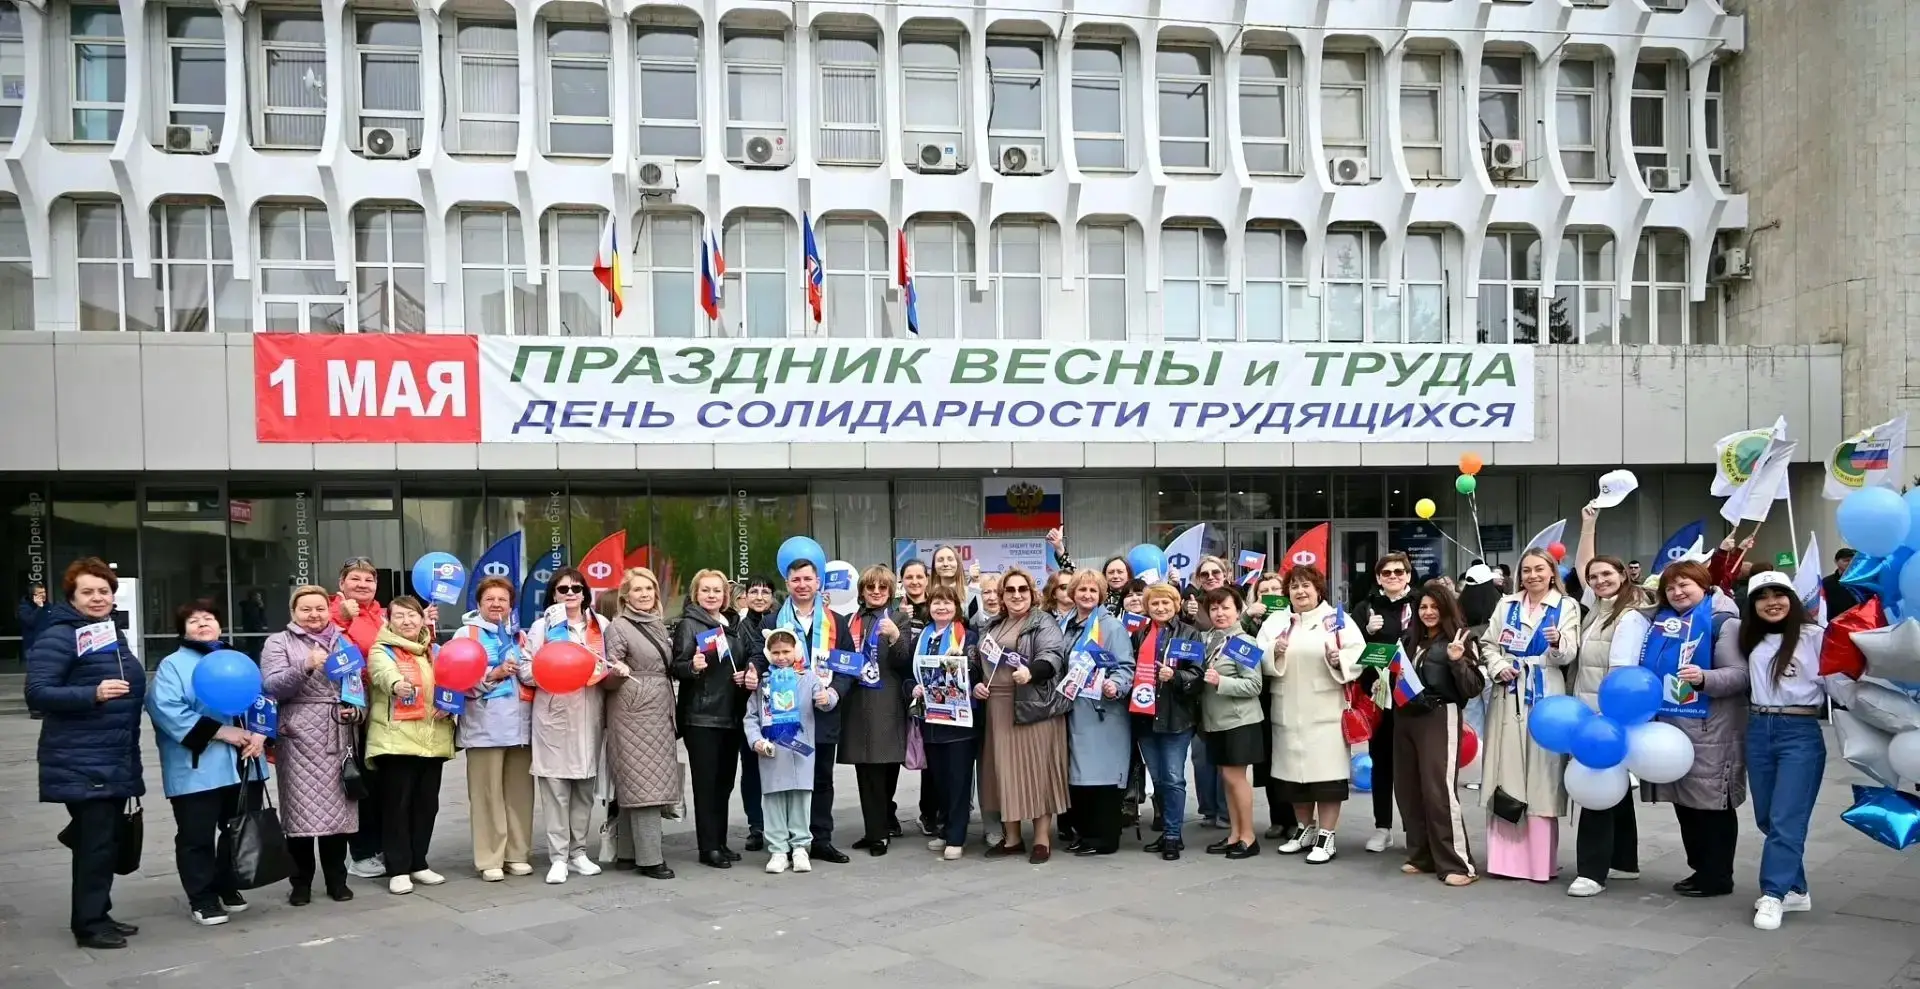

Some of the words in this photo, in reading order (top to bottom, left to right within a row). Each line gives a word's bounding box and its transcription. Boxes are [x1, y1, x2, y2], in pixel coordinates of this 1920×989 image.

[269, 358, 297, 417] 1
[327, 359, 467, 418] МАЯ
[509, 345, 929, 394] ПРАЗДНИК
[949, 348, 1223, 387] ВЕСНЫ
[1243, 360, 1279, 386] и
[1305, 350, 1518, 396] ТРУДА
[512, 400, 675, 434] ДЕНЬ
[697, 400, 1149, 434] СОЛИДАРНОСТИ
[1167, 402, 1516, 435] ТРУДЯЩИХСЯ
[295, 491, 309, 535] рядом
[545, 491, 560, 523] банк
[735, 489, 748, 584] Технологично
[296, 538, 309, 586] Всегда
[588, 561, 612, 579] Ф
